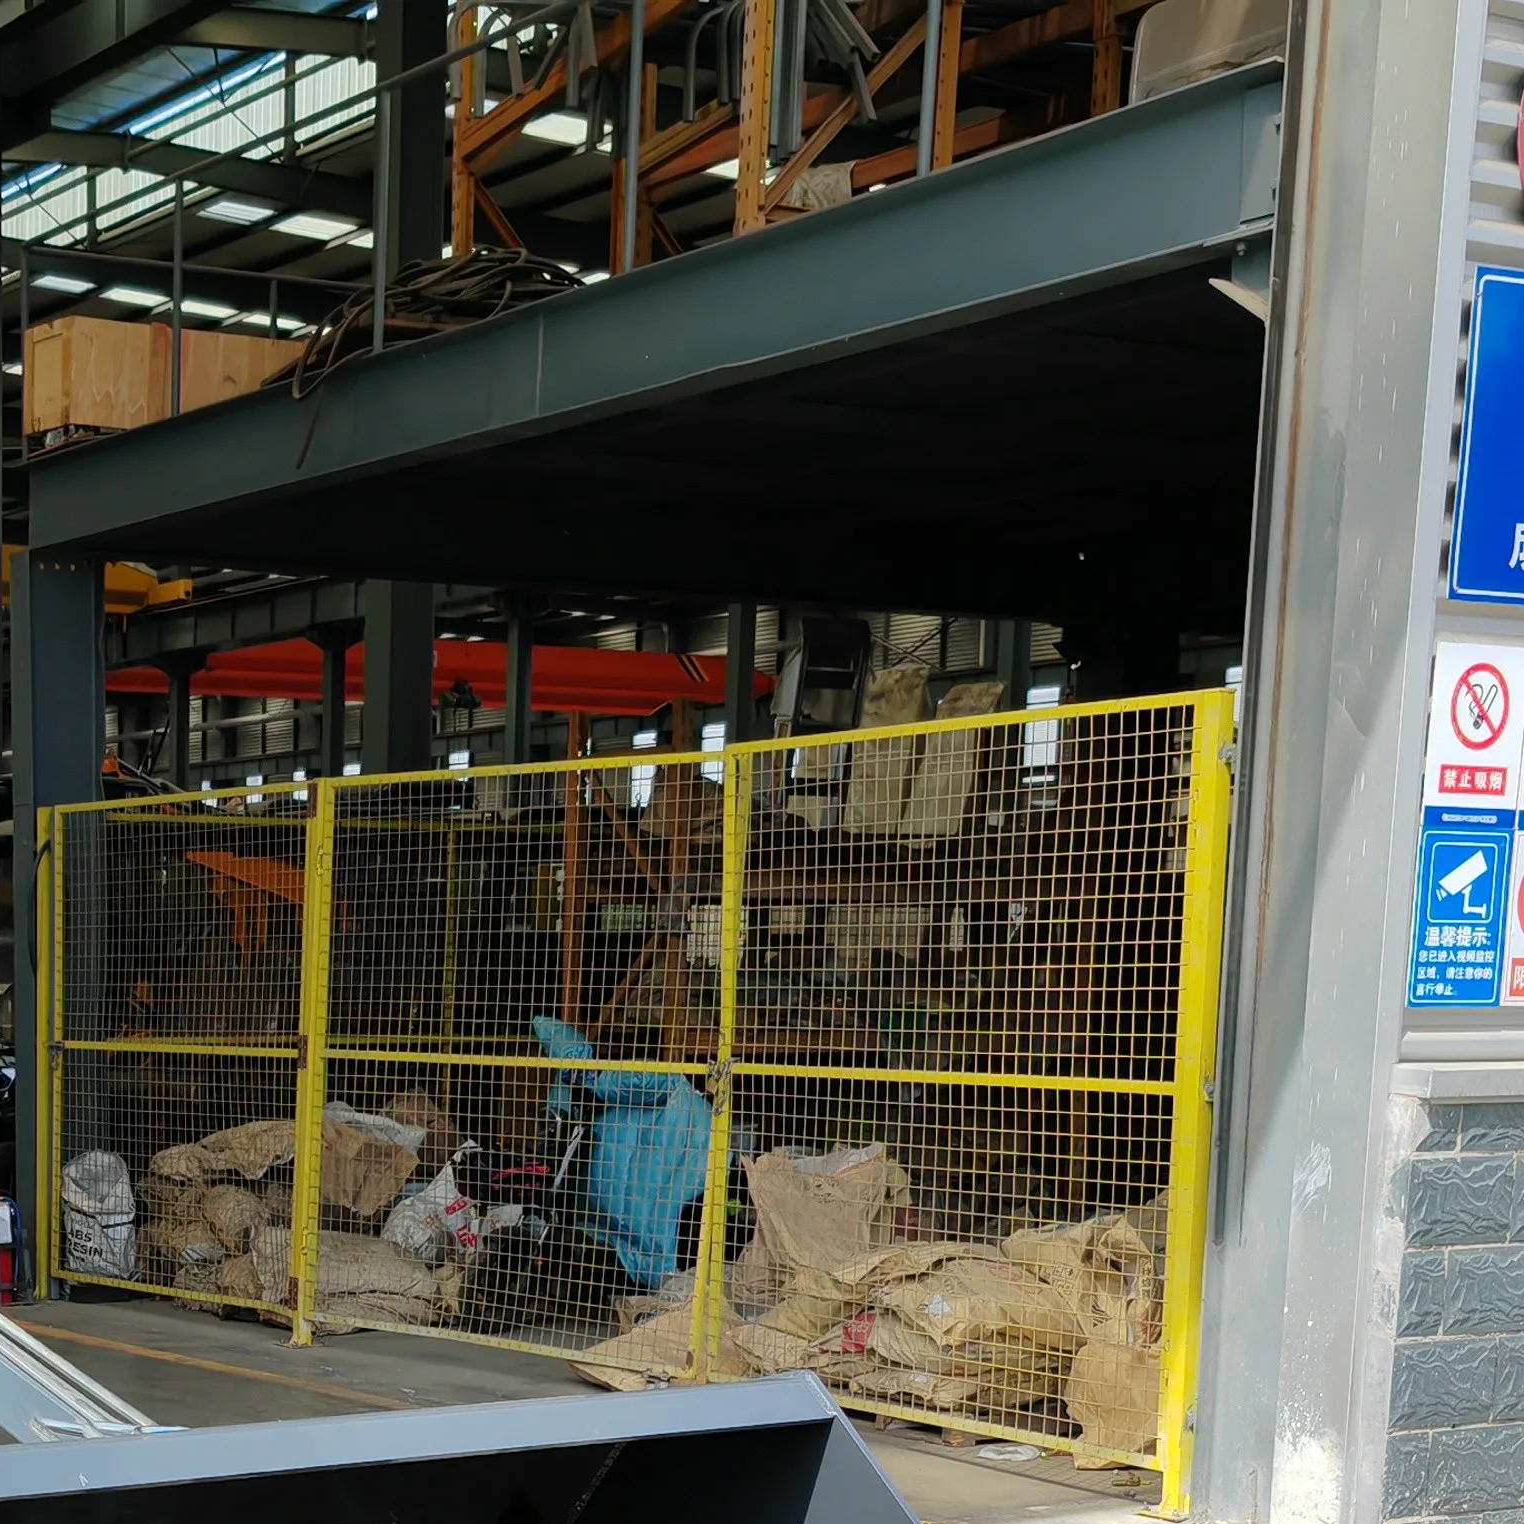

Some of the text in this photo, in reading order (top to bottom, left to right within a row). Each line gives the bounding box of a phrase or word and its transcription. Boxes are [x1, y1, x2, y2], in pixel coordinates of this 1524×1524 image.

[1443, 769, 1503, 790] 禁止吸烟
[1418, 949, 1496, 963] 您已进入视频监控
[1416, 966, 1493, 980] 区域，请注意你的
